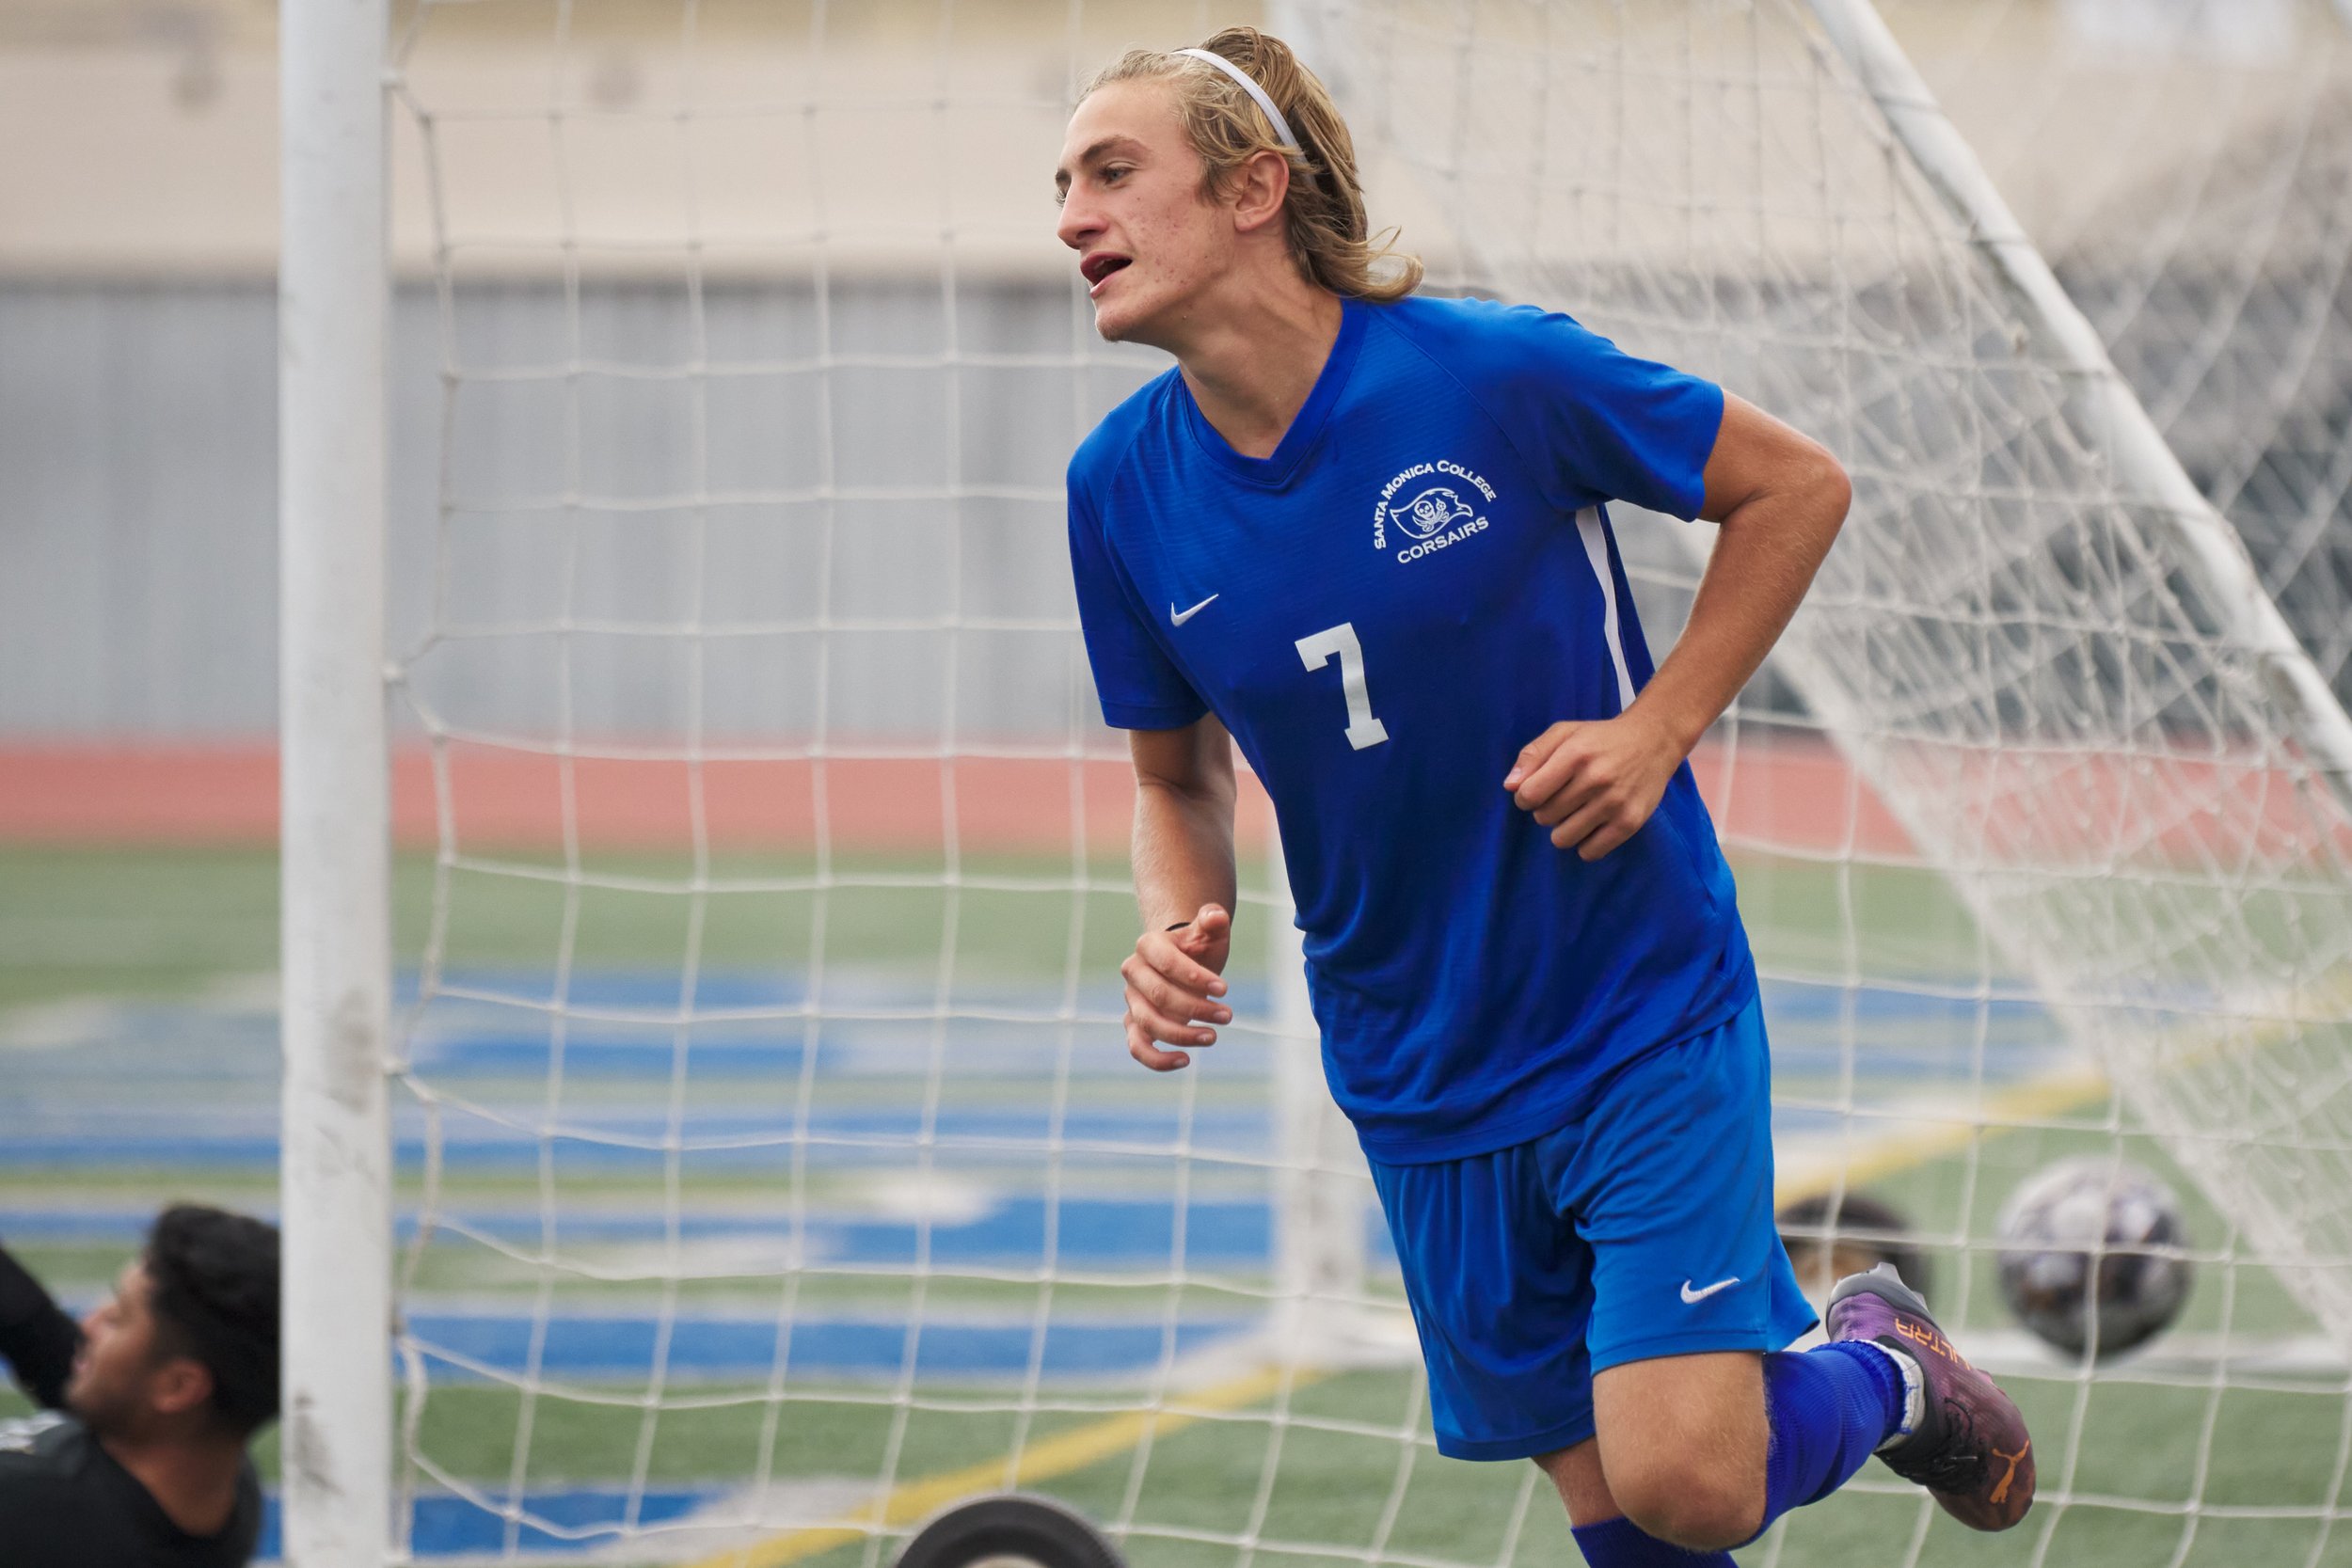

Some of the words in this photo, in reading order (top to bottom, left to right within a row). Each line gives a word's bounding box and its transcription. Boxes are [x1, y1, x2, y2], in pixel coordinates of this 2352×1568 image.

[1381, 463, 1435, 500] MONICA
[1437, 460, 1497, 502] COLLEGE
[1375, 501, 1388, 549] SANTA
[1397, 516, 1489, 563] CORSAIRS
[1294, 622, 1390, 751] 7
